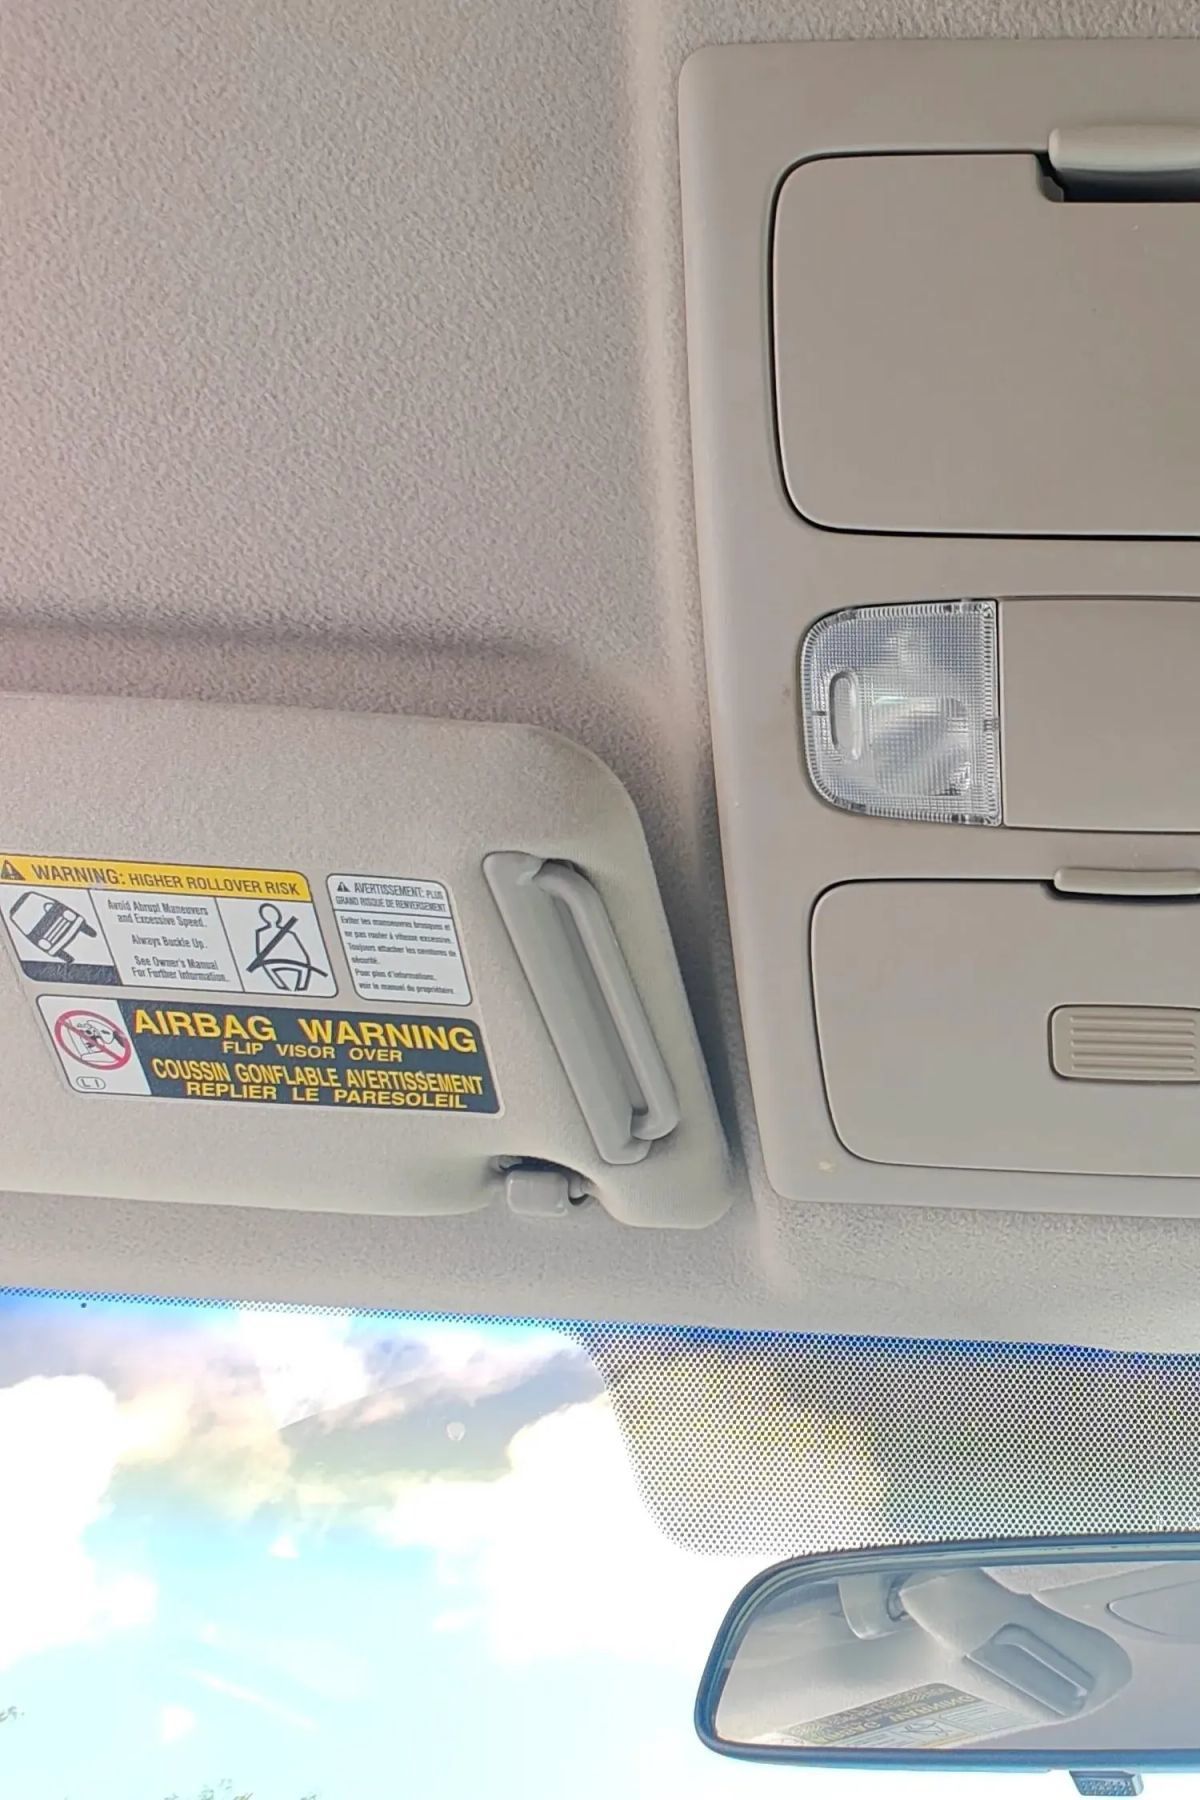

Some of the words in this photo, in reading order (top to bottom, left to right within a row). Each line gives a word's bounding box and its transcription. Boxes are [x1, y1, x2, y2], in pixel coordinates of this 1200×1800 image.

[30, 864, 125, 884] WARNING:
[129, 873, 183, 888] HIGHER
[188, 877, 262, 893] ROLLOVER
[267, 881, 300, 896] RISK
[107, 900, 132, 911] Avoid
[132, 901, 162, 915] Abrupt
[162, 903, 209, 915] Maneuvers
[117, 913, 134, 923] and
[134, 914, 176, 925] Excessive
[177, 917, 205, 928] Speed.
[131, 935, 162, 948] Always
[162, 936, 191, 947] Buckle
[191, 938, 208, 950] Up.
[135, 956, 152, 966] See
[152, 957, 186, 968] Owner's
[187, 959, 219, 969] Manual
[132, 967, 147, 977] For
[147, 968, 178, 979] Further
[178, 970, 227, 981] Information.
[135, 1010, 276, 1041] AIRBAG
[298, 1018, 477, 1052] WARNING
[222, 1041, 262, 1055] FLIP
[276, 1044, 336, 1059] VISOR
[352, 1047, 402, 1062] OVER
[151, 1058, 230, 1081] COUSSIN
[235, 1061, 339, 1087] GONFLABLE
[346, 1069, 483, 1095] AVERTISSEMENT
[187, 1082, 277, 1099] REPLIER
[292, 1086, 320, 1101] LE
[334, 1088, 468, 1108] PARESOLEIL
